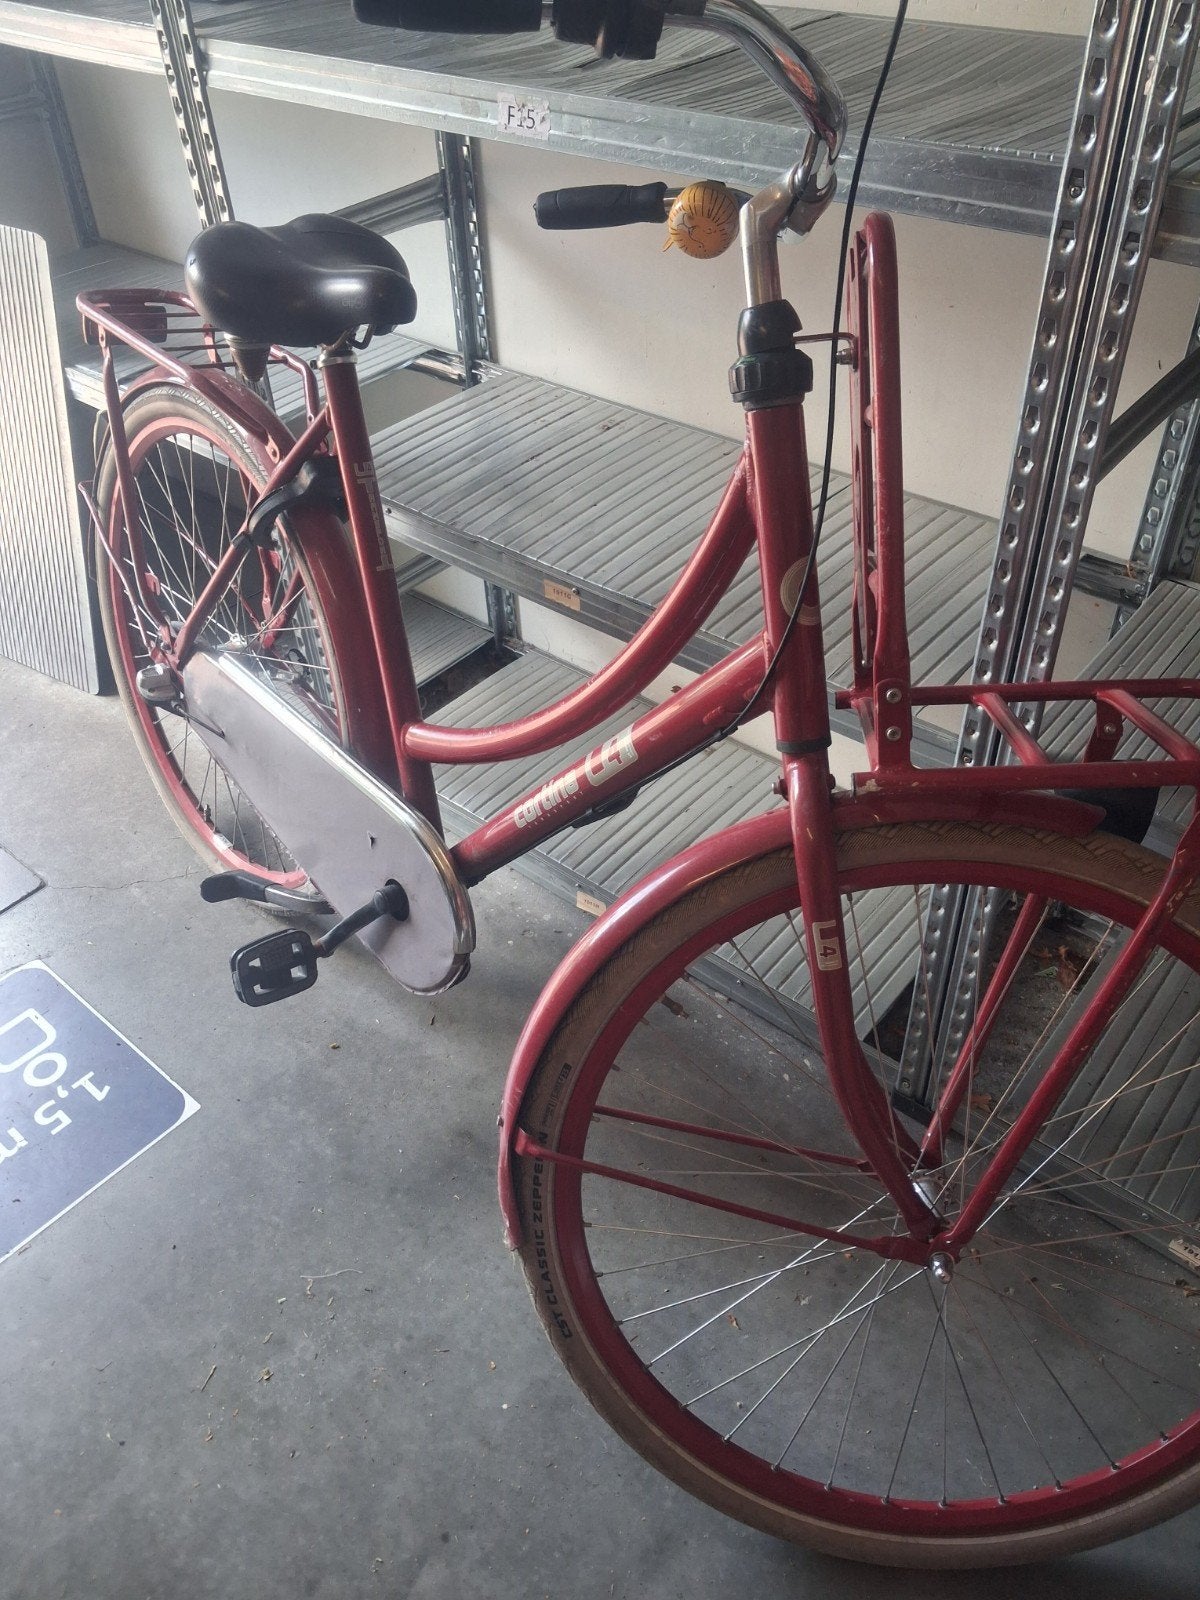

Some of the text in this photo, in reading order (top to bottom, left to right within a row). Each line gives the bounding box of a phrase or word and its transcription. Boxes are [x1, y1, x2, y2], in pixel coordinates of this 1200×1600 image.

[507, 105, 536, 129] F15
[513, 768, 580, 829] cortina
[584, 722, 639, 787] U4
[812, 919, 843, 971] U4
[34, 1071, 111, 1136] 1,5
[532, 1131, 574, 1340] CST CLASSIC ZEPPEN
